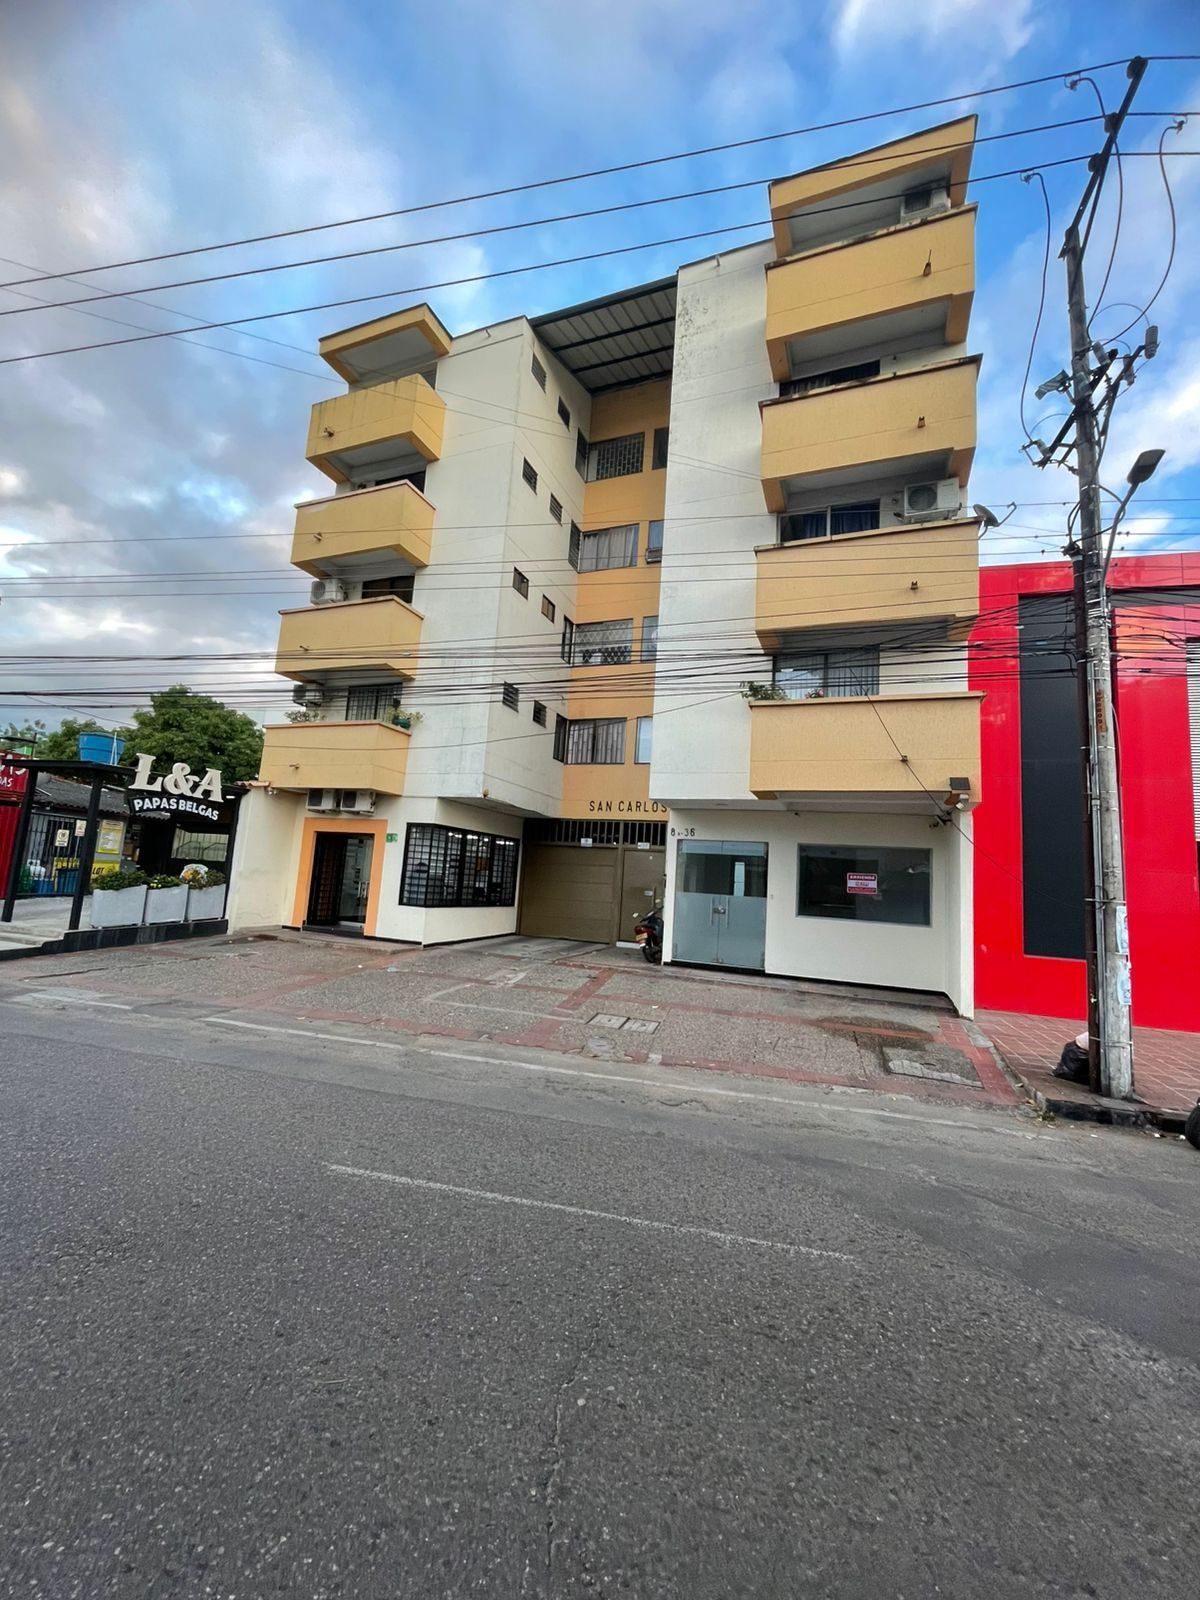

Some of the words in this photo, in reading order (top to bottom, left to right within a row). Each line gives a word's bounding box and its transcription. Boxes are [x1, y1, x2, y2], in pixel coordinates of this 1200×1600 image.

[128, 753, 224, 802] L&A
[134, 797, 177, 811] PAPAS
[178, 801, 219, 820] BELGAS
[589, 800, 612, 812] SAN
[618, 800, 667, 813] CARLOS
